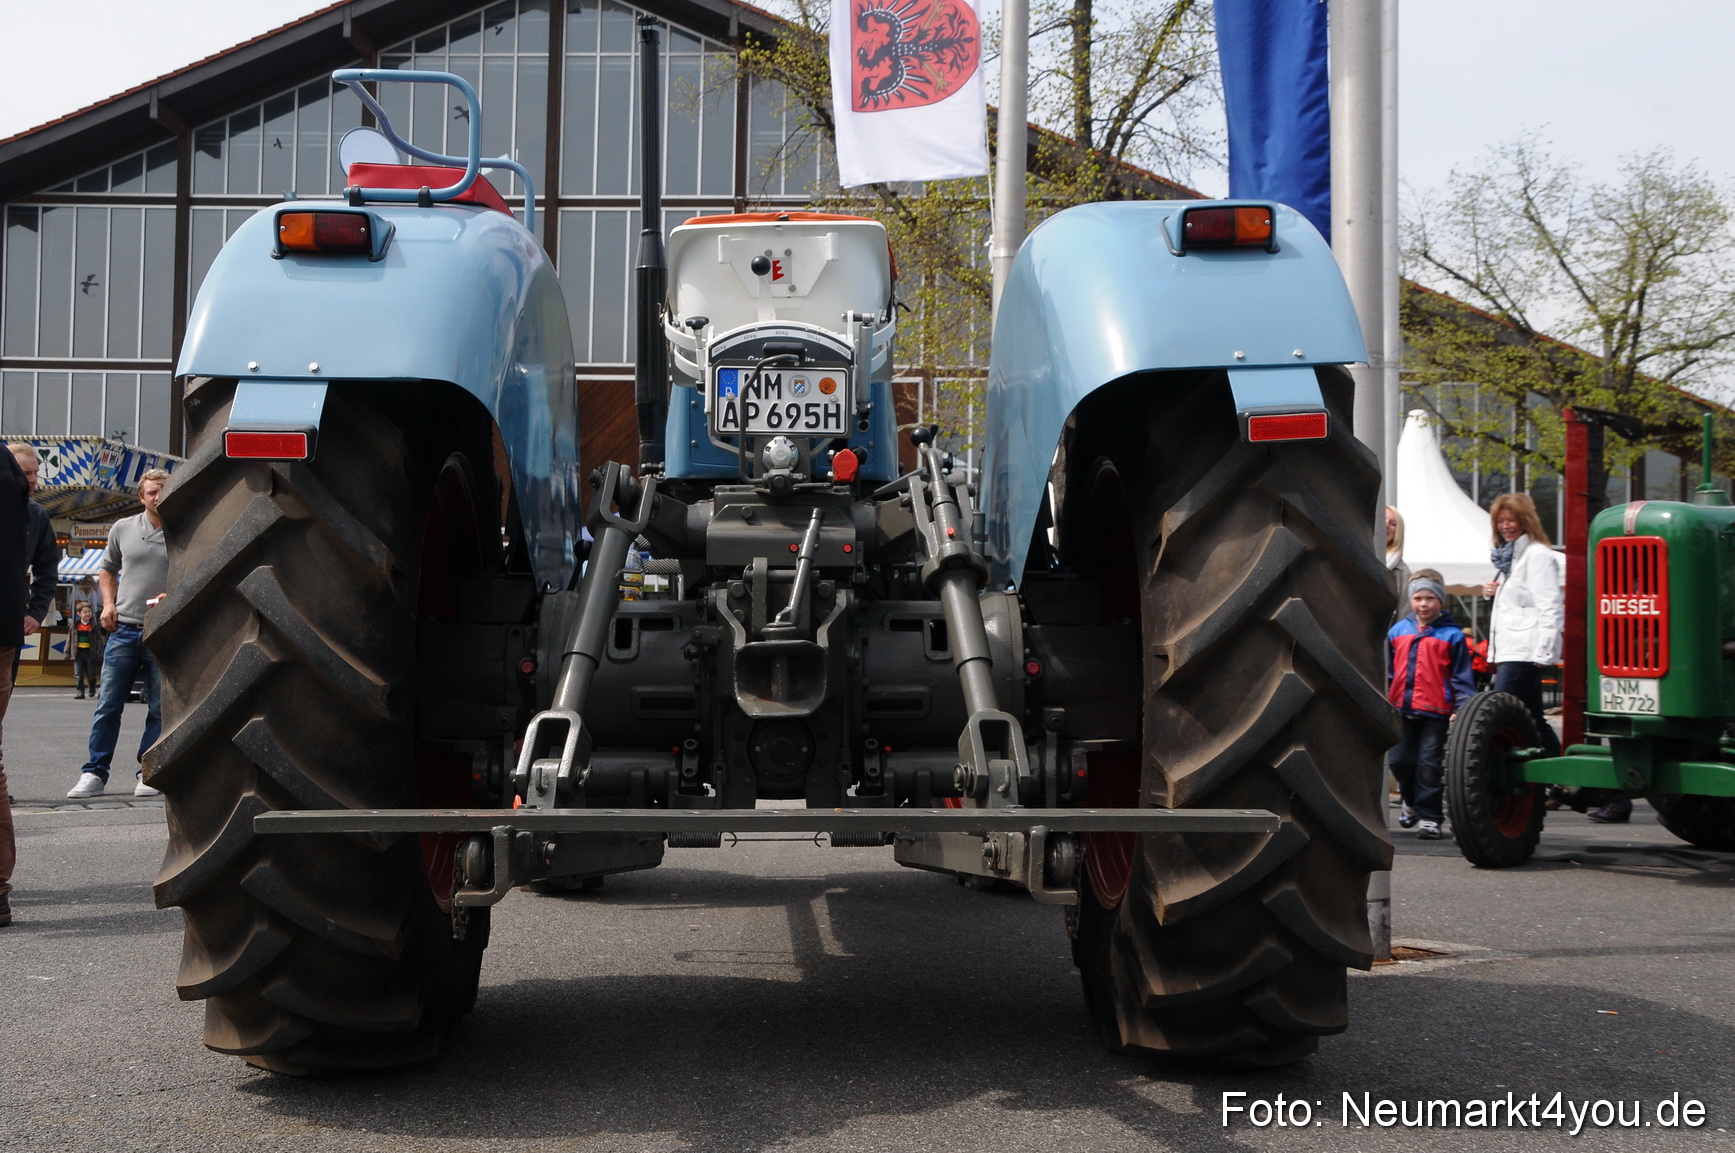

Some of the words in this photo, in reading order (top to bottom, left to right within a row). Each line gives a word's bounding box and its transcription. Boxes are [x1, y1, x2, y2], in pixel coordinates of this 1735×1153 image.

[744, 373, 782, 399] NM
[722, 401, 760, 428] AP
[766, 402, 841, 429] 695H
[1600, 599, 1661, 615] DIESEL
[1617, 680, 1640, 695] NM
[1604, 695, 1625, 711] HR
[1628, 696, 1655, 712] 722
